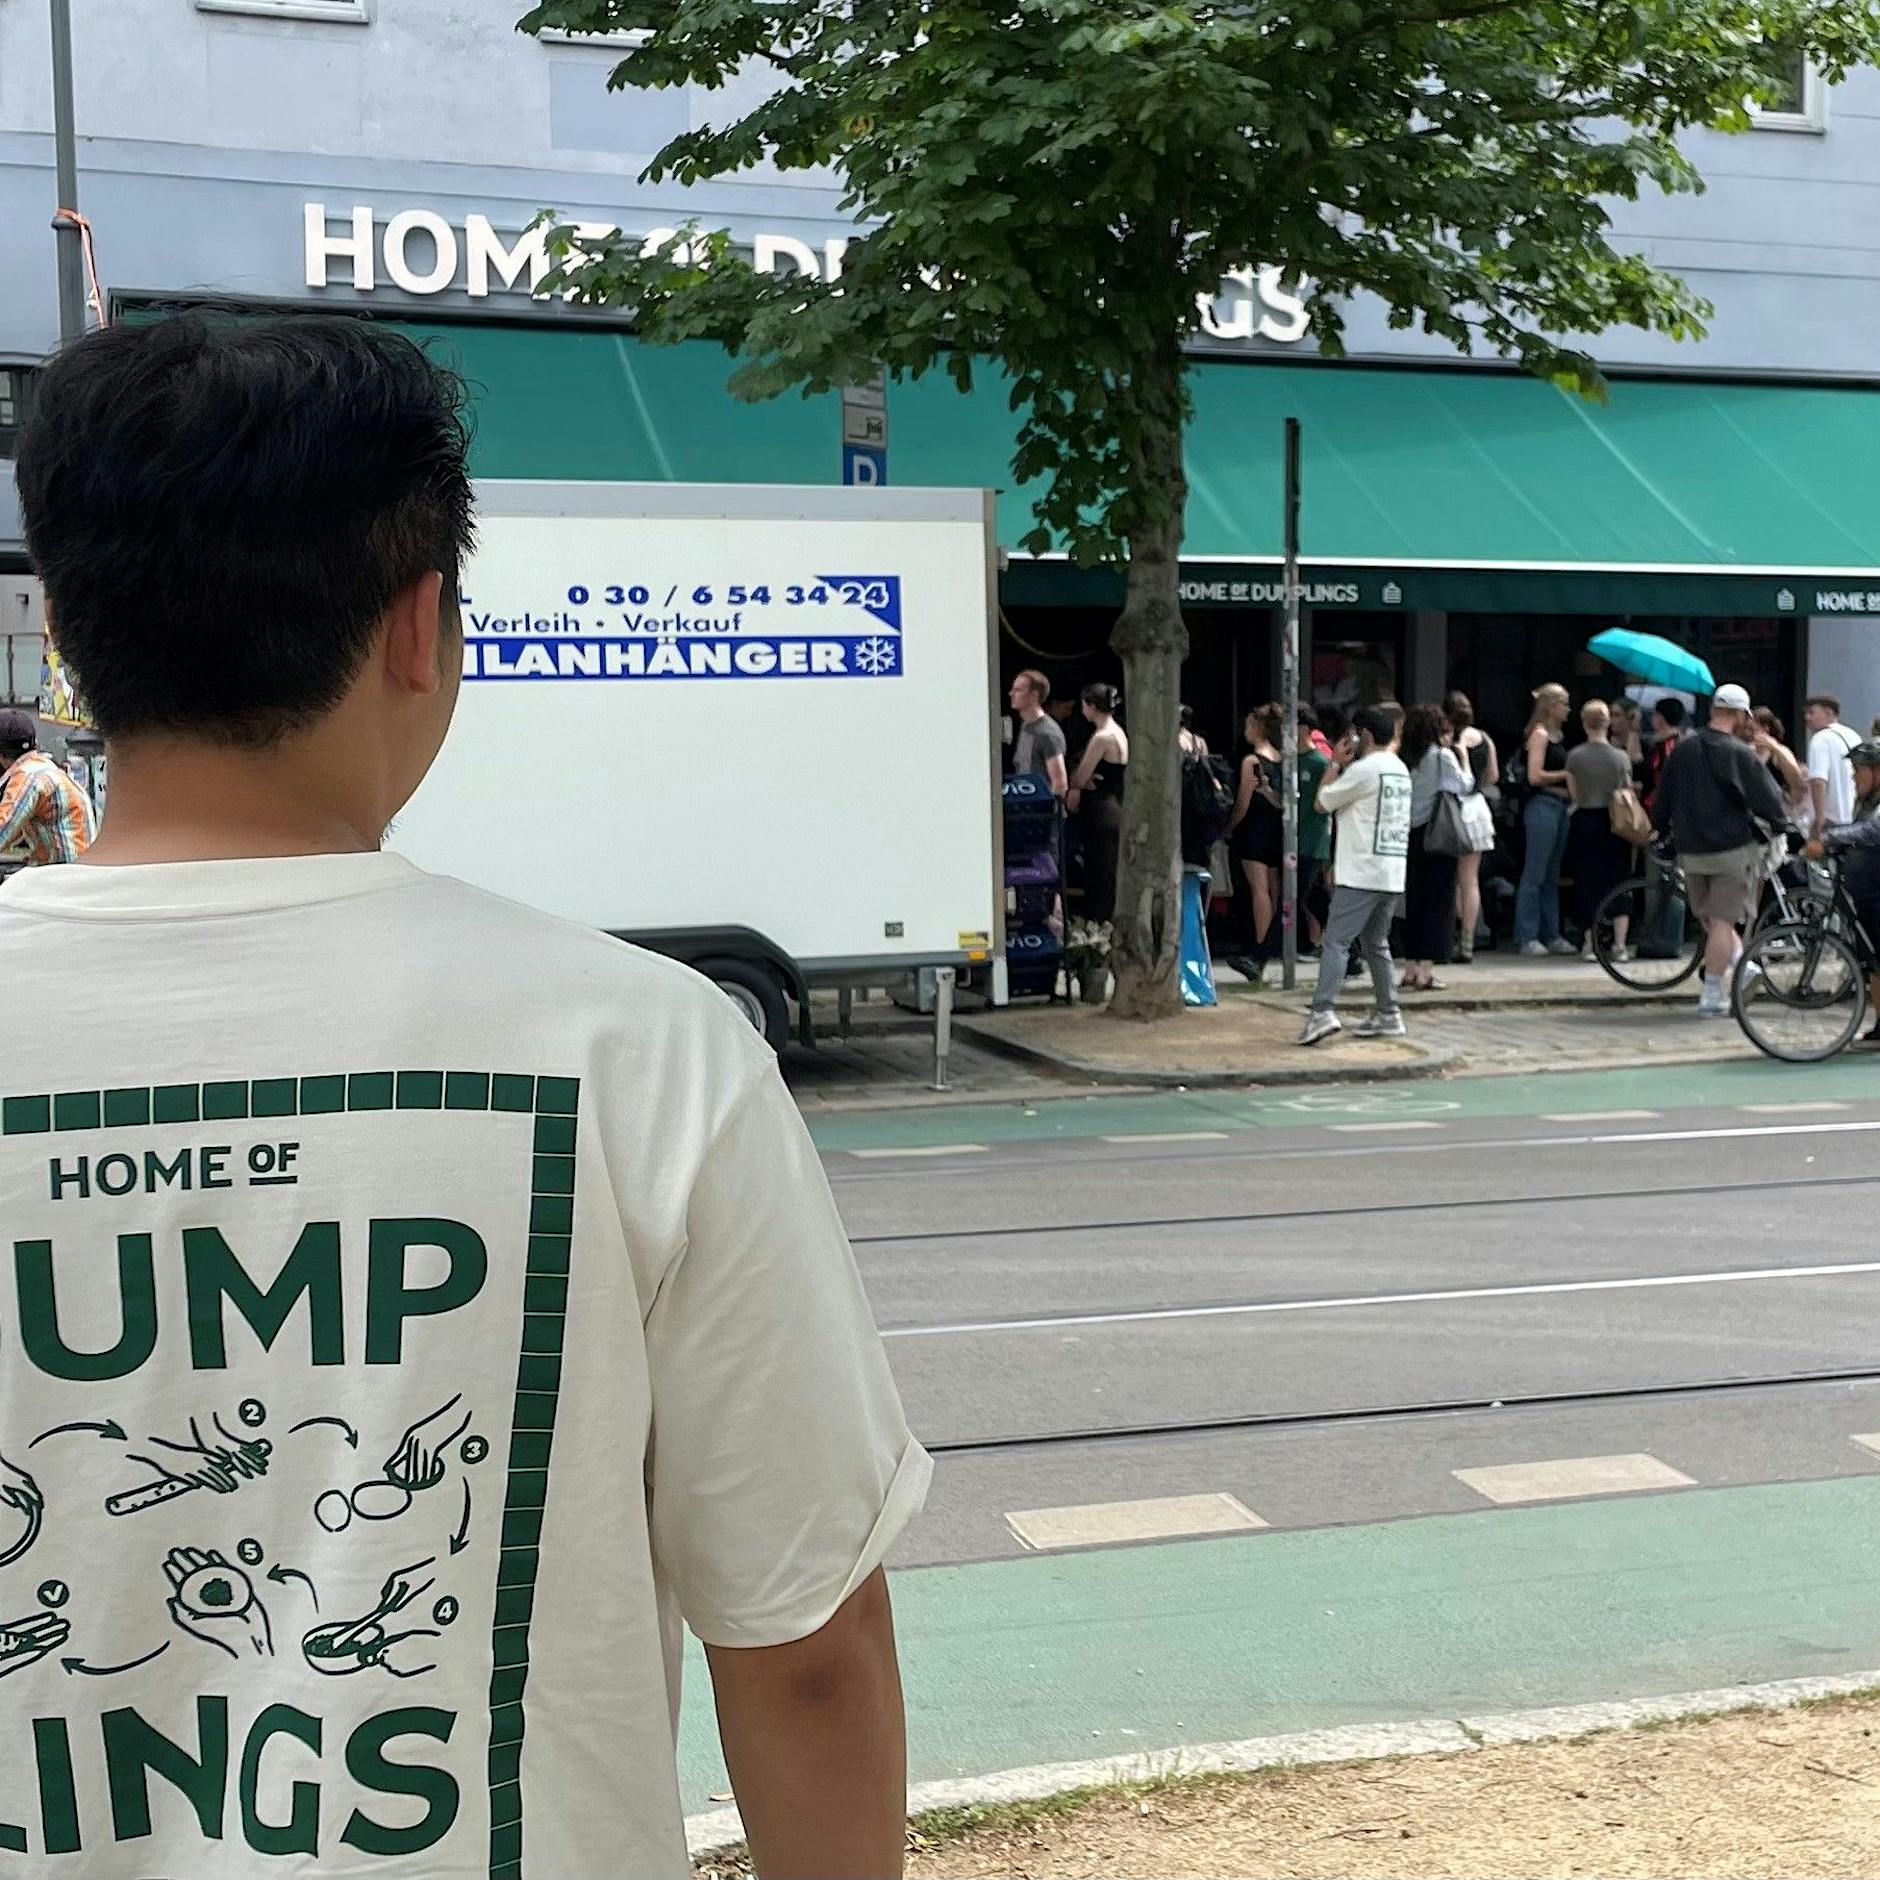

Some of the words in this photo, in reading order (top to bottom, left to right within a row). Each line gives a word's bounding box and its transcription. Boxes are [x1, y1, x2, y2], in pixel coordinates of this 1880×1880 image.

[567, 585, 589, 605] 0
[604, 585, 650, 605] 30
[692, 585, 713, 605] 6
[726, 585, 772, 605] 54
[784, 585, 829, 605] 34
[841, 584, 886, 605] 24
[1816, 591, 1866, 612] HOME
[470, 612, 580, 632] Verleih
[622, 612, 743, 633] Verkauf
[50, 1145, 233, 1200] HOME
[247, 1142, 301, 1185] OF
[0, 1216, 489, 1383] UMP
